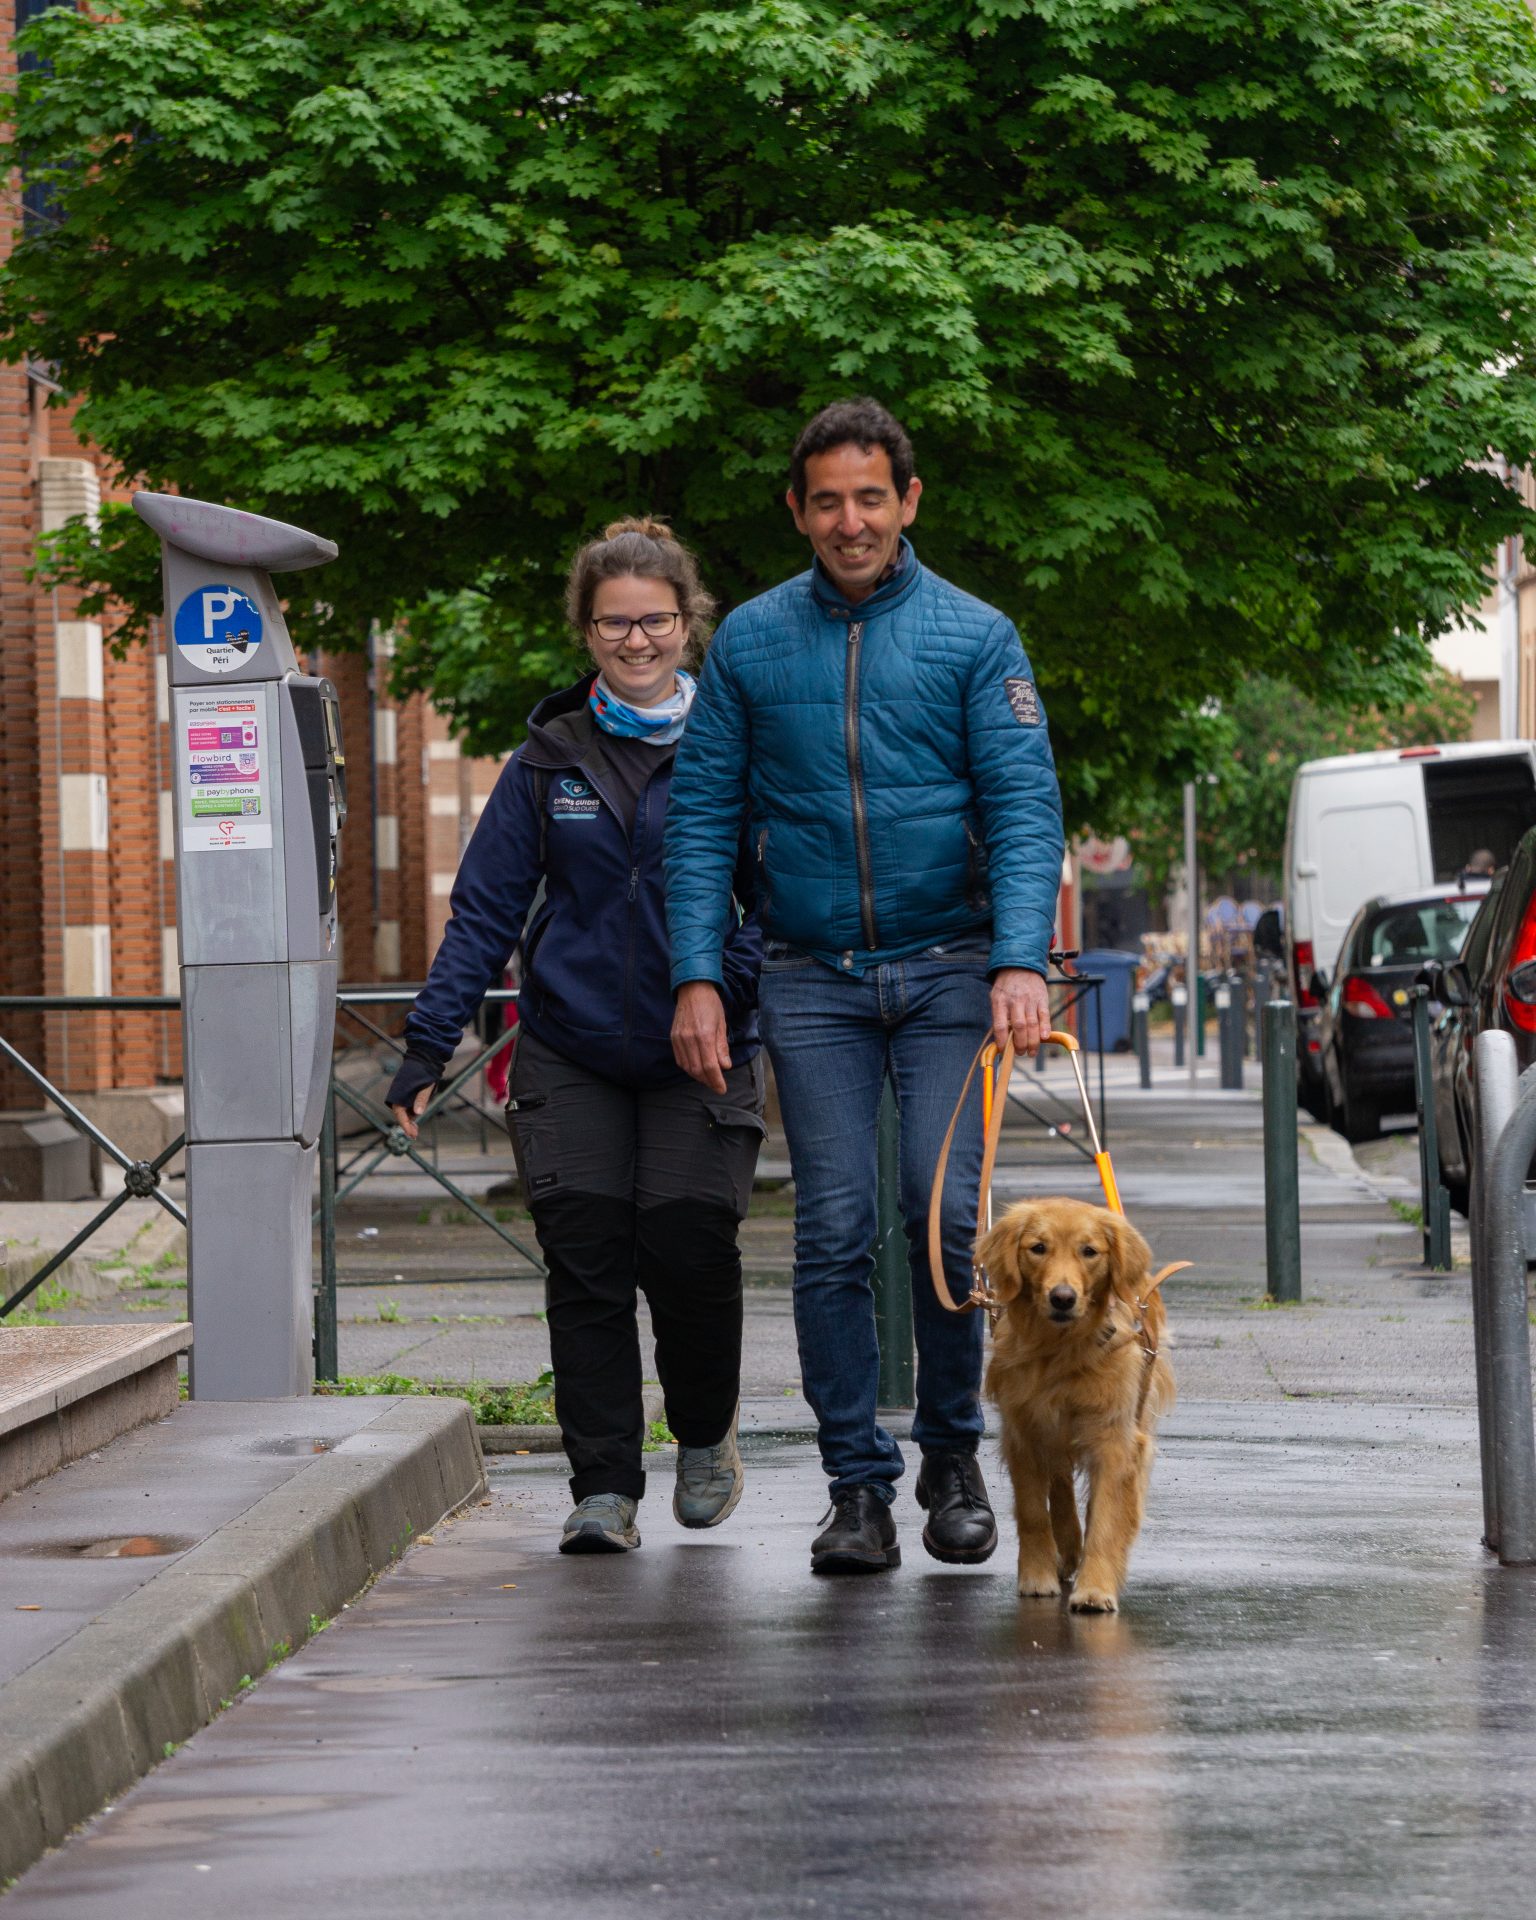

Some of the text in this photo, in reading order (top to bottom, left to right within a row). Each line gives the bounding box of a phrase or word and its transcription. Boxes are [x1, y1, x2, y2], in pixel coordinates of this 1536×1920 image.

[203, 592, 235, 638] P
[213, 656, 229, 664] Péri
[207, 788, 254, 796] paybyphone
